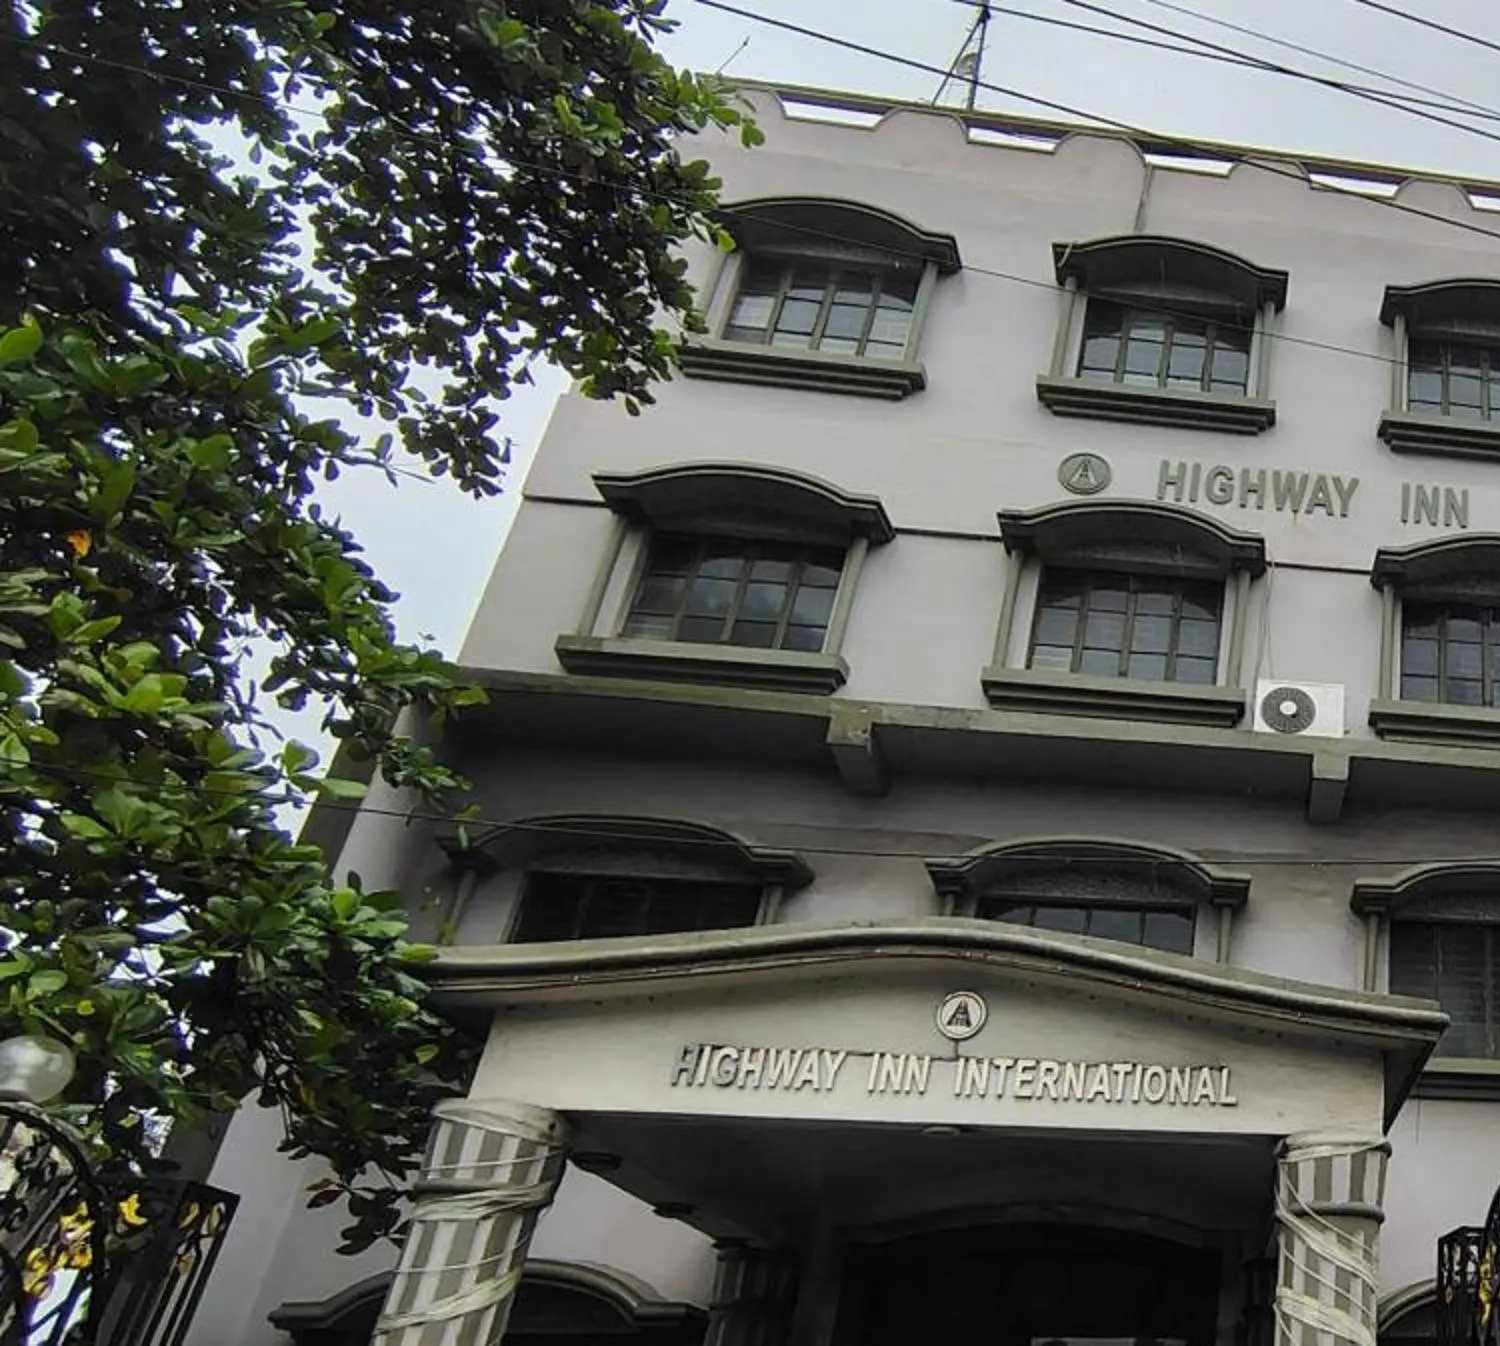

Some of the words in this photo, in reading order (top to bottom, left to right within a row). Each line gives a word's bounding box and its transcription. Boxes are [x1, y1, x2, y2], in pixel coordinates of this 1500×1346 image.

[1156, 459, 1359, 517] HIGHWAY
[1400, 481, 1469, 528] INN
[671, 1045, 847, 1091] HIGHWAY
[866, 1052, 931, 1095] INN
[954, 1057, 1238, 1106] INTERNATIONAL
